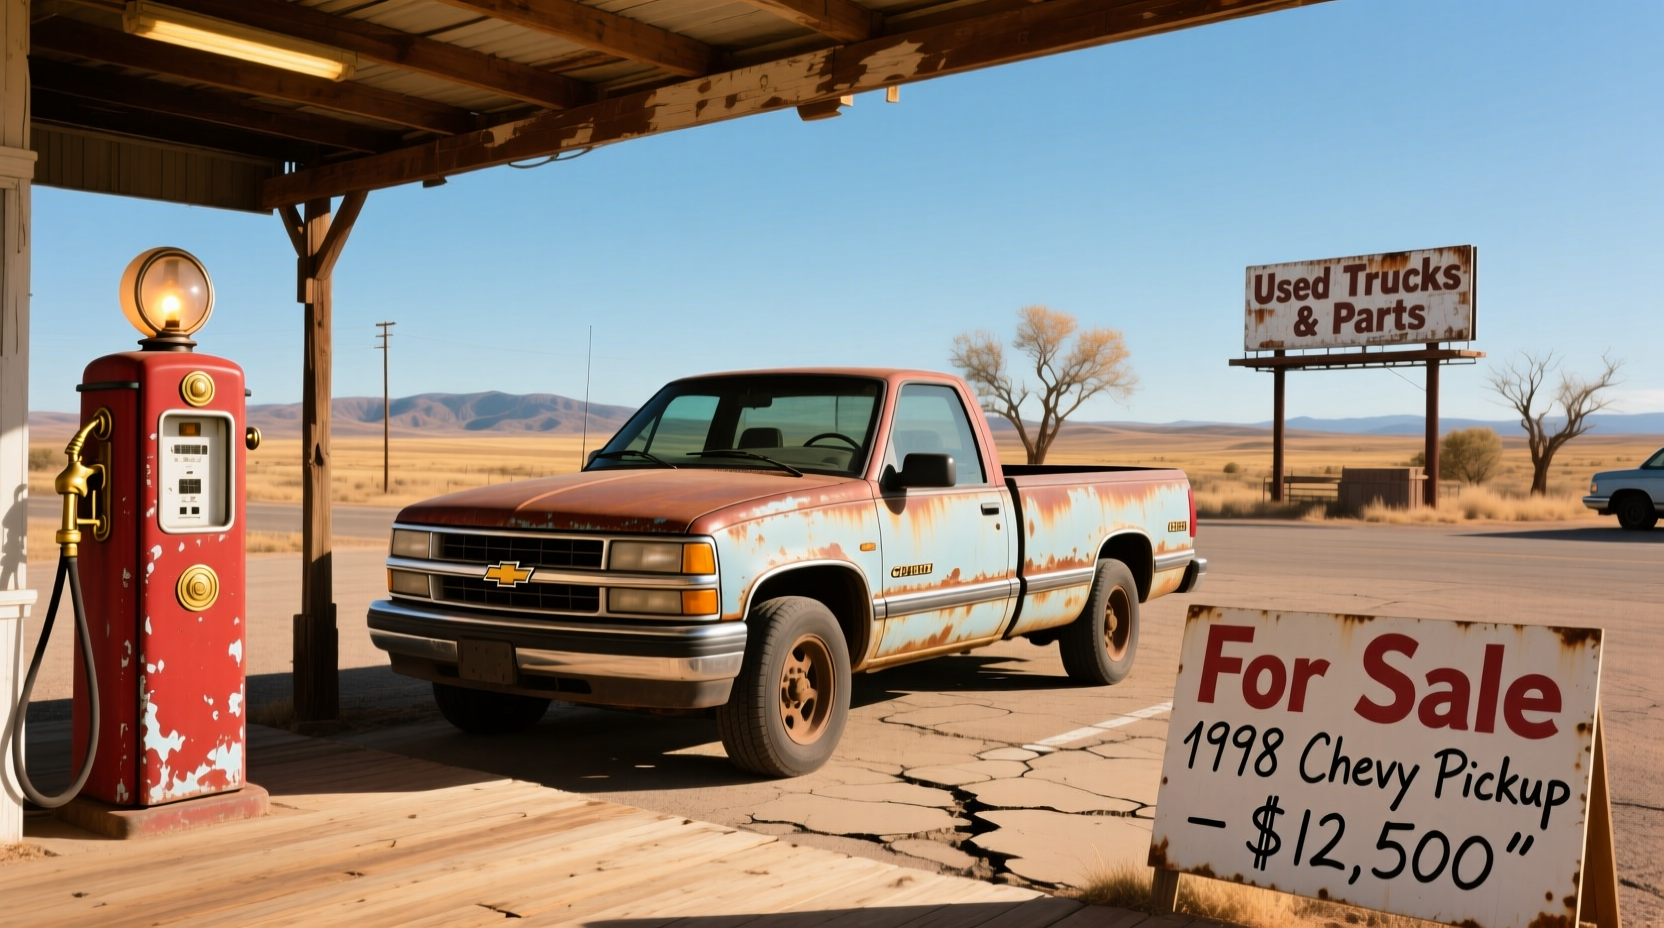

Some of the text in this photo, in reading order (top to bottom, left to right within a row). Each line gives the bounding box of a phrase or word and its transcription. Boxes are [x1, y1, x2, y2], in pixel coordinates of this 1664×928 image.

[1254, 257, 1461, 305] Used Trucks
[1293, 299, 1426, 337] & Parts
[1197, 624, 1562, 740] For Sale
[1183, 720, 1571, 830] 1998 Chevy Pickup
